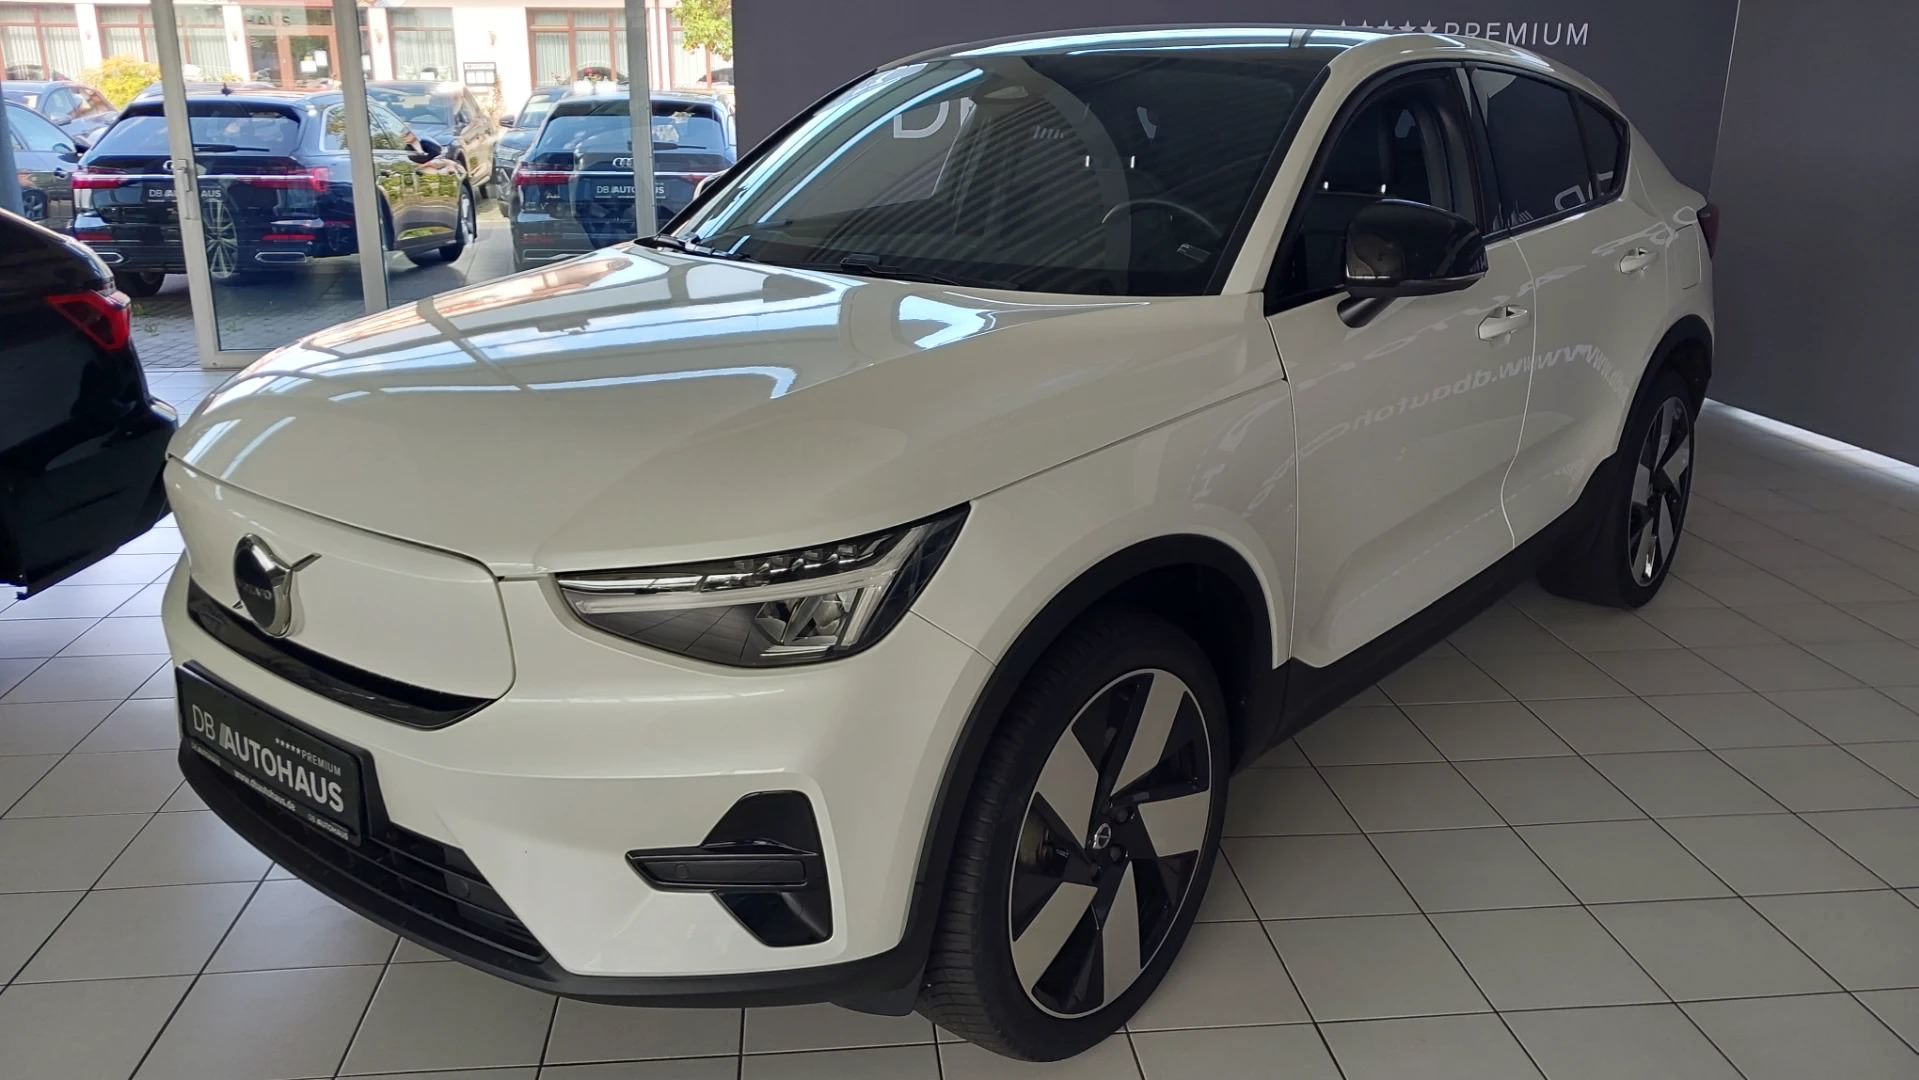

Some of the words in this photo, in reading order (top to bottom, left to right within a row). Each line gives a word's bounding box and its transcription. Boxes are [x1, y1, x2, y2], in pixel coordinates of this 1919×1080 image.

[192, 703, 216, 740] DB
[219, 722, 344, 812] AUTOHAUS
[301, 749, 341, 777] PREMIUM
